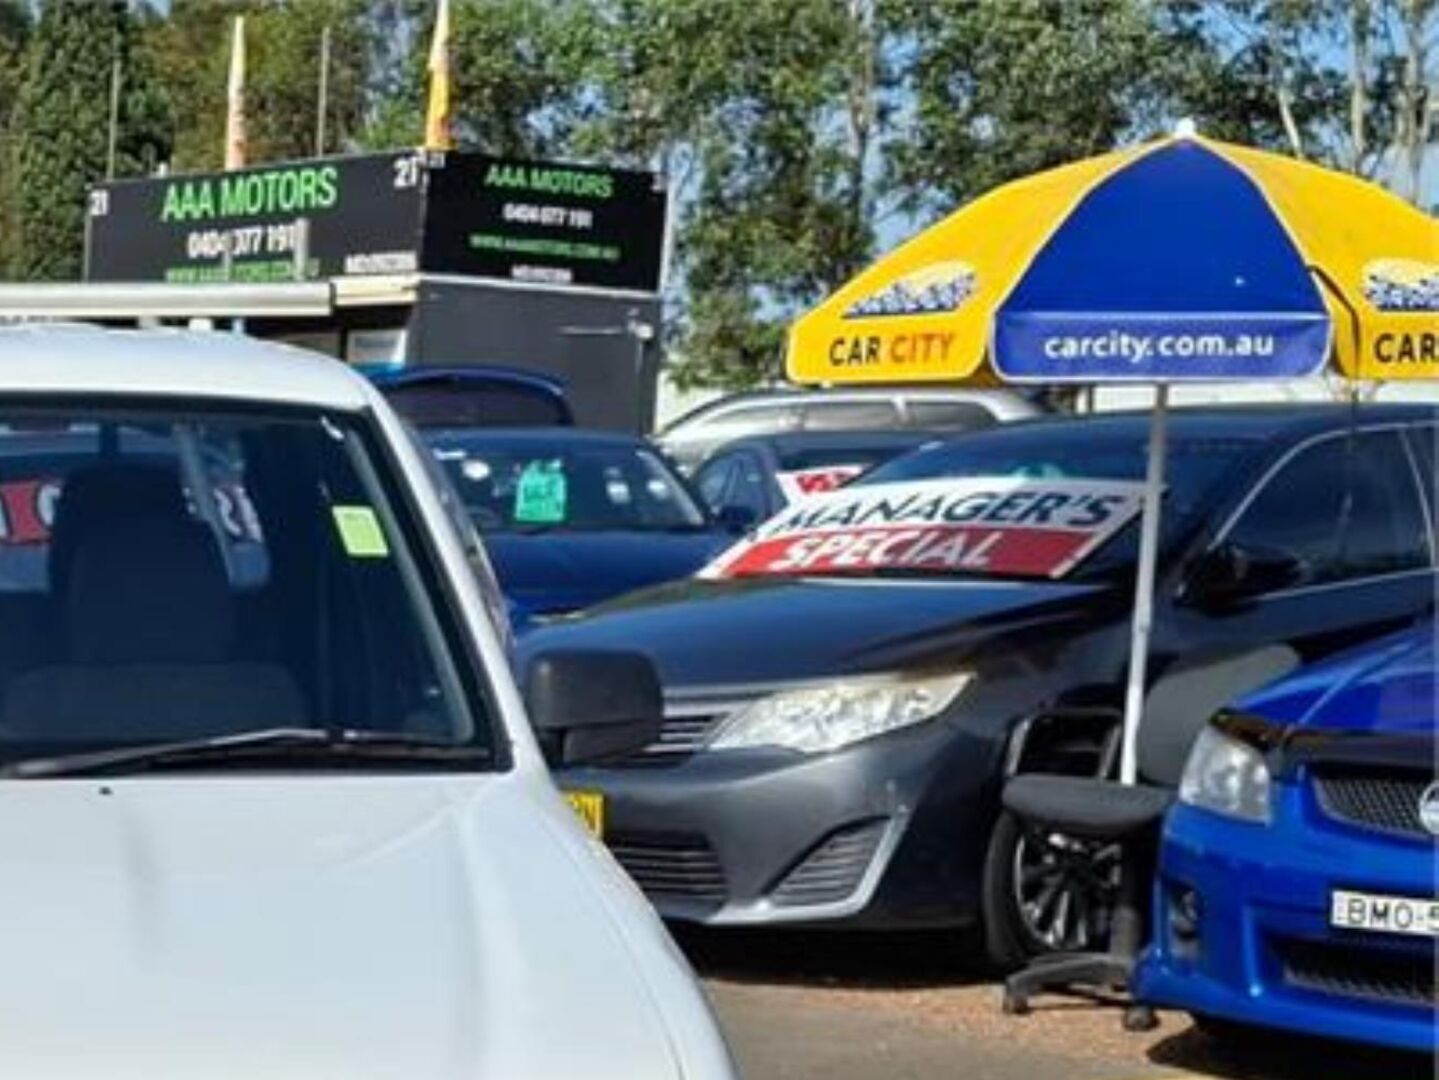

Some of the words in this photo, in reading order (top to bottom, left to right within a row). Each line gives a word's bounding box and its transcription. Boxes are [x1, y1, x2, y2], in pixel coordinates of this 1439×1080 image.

[162, 182, 215, 222] AAA
[220, 166, 338, 217] MOTORS
[485, 164, 526, 190] AAA
[530, 168, 615, 198] MOTORS
[829, 336, 881, 366] CAR
[889, 332, 956, 364] CITY
[1044, 330, 1274, 364] carcity.com.au
[774, 490, 1127, 532] MANAGER'S
[767, 529, 1003, 572] SPECIAL
